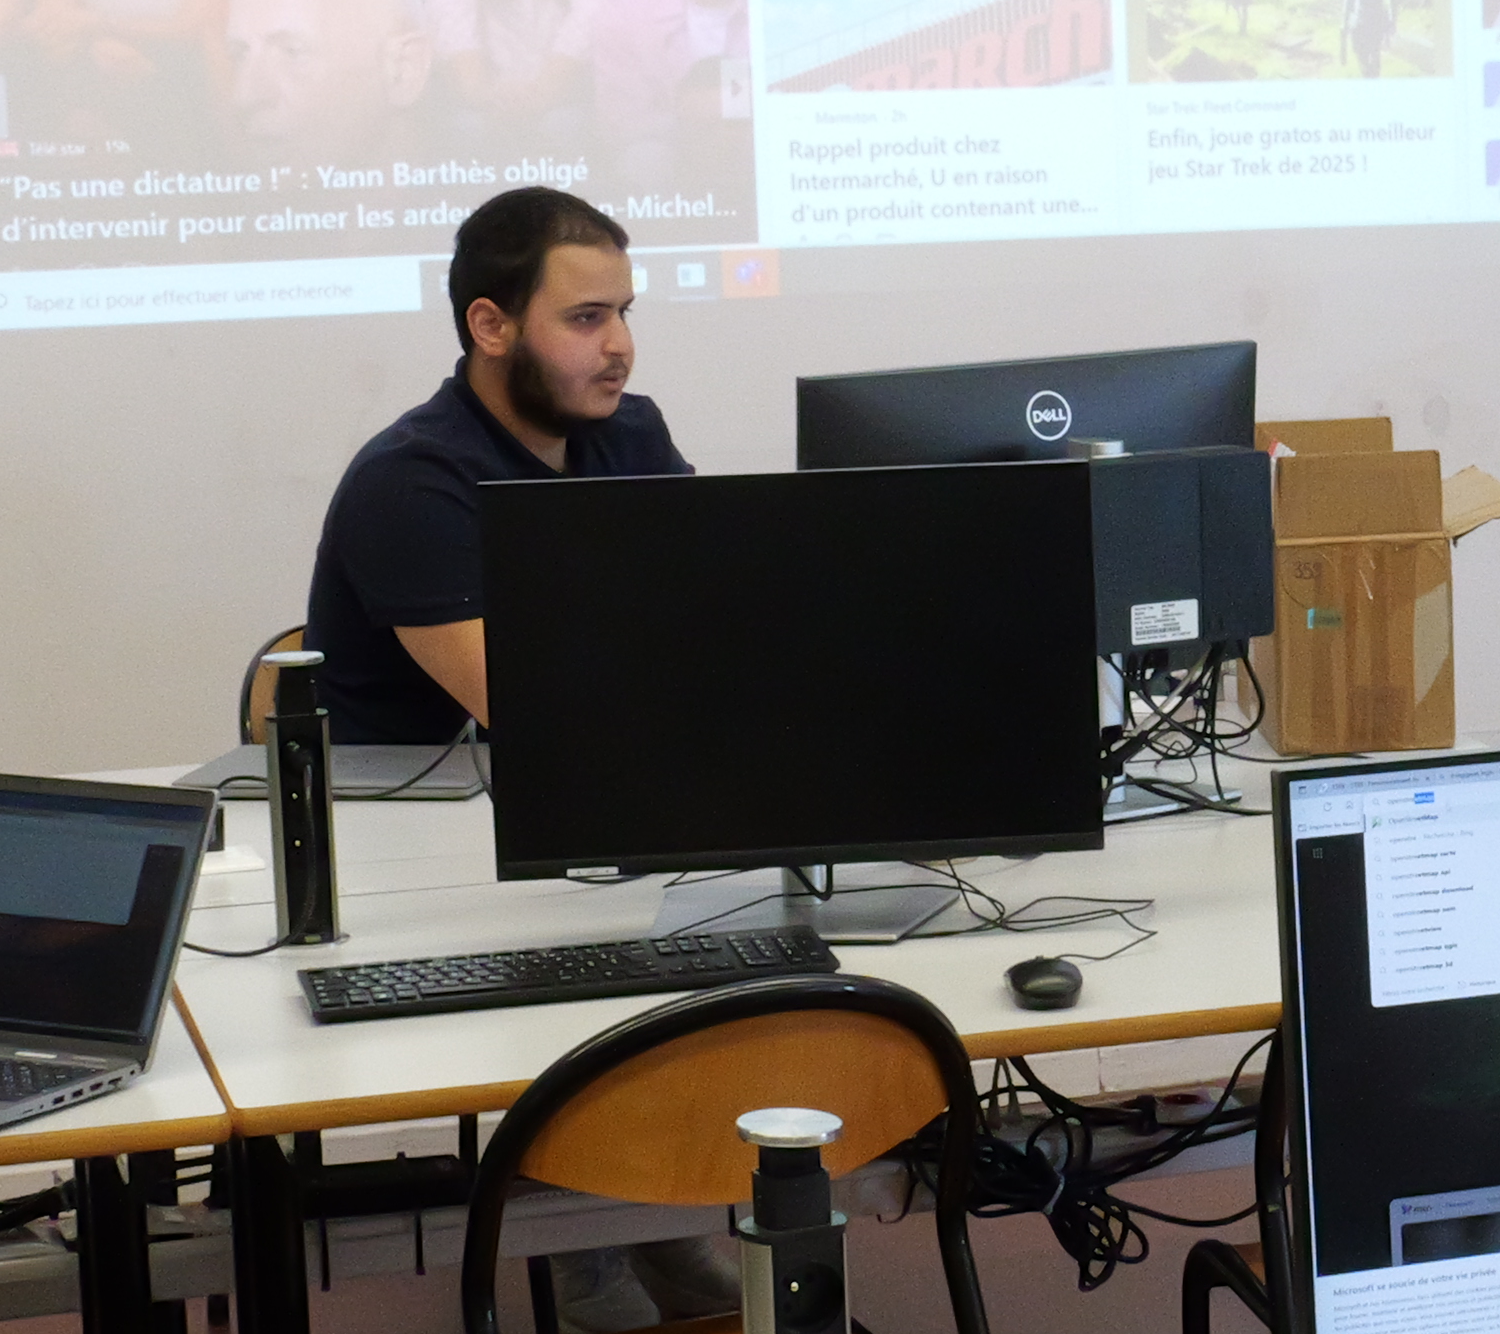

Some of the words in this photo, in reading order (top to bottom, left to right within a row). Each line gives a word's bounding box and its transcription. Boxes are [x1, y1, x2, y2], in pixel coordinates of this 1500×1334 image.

[1146, 100, 1170, 116] Star
[1203, 98, 1232, 114] Fleet
[1234, 97, 1298, 114] Command
[789, 138, 863, 162] Rappel
[869, 135, 948, 161] produit
[954, 135, 1002, 157] chez
[1147, 126, 1205, 152] Enfin,
[1207, 126, 1254, 151] joue
[1259, 125, 1323, 150] gratos
[1328, 126, 1352, 143] au
[1357, 122, 1437, 143] meilleur
[70, 175, 126, 200] une
[132, 165, 262, 197] dictature
[315, 163, 385, 190] Yann
[391, 158, 497, 186] Barthès
[503, 156, 588, 190] obligé
[790, 165, 925, 194] Intermarché,
[930, 167, 946, 187] U
[952, 170, 980, 186] en
[984, 165, 1049, 186] raison
[1147, 157, 1180, 184] jeu
[1185, 159, 1224, 179] Star
[1232, 156, 1273, 178] Trek
[1278, 155, 1304, 176] de
[1307, 153, 1356, 175] 2025
[177, 212, 248, 246] pour
[253, 202, 349, 236] calmer
[357, 201, 395, 230] les
[402, 198, 472, 229] arde
[791, 202, 840, 225] d'un
[845, 198, 925, 225] produit
[930, 194, 1036, 219] contenant
[1042, 195, 1099, 216] une...
[25, 290, 76, 316] Tapez
[78, 291, 101, 312] ici
[105, 291, 148, 314] pour
[152, 284, 231, 312] effectuer
[234, 285, 267, 306] une
[269, 280, 355, 303] recherche
[1032, 408, 1066, 423] DELL
[1333, 1284, 1375, 1297] Microsoft
[1389, 1278, 1416, 1290] soucie
[1418, 1277, 1429, 1285] de
[1431, 1274, 1453, 1284] votre
[1456, 1271, 1468, 1281] vie
[1471, 1268, 1496, 1280] privée
